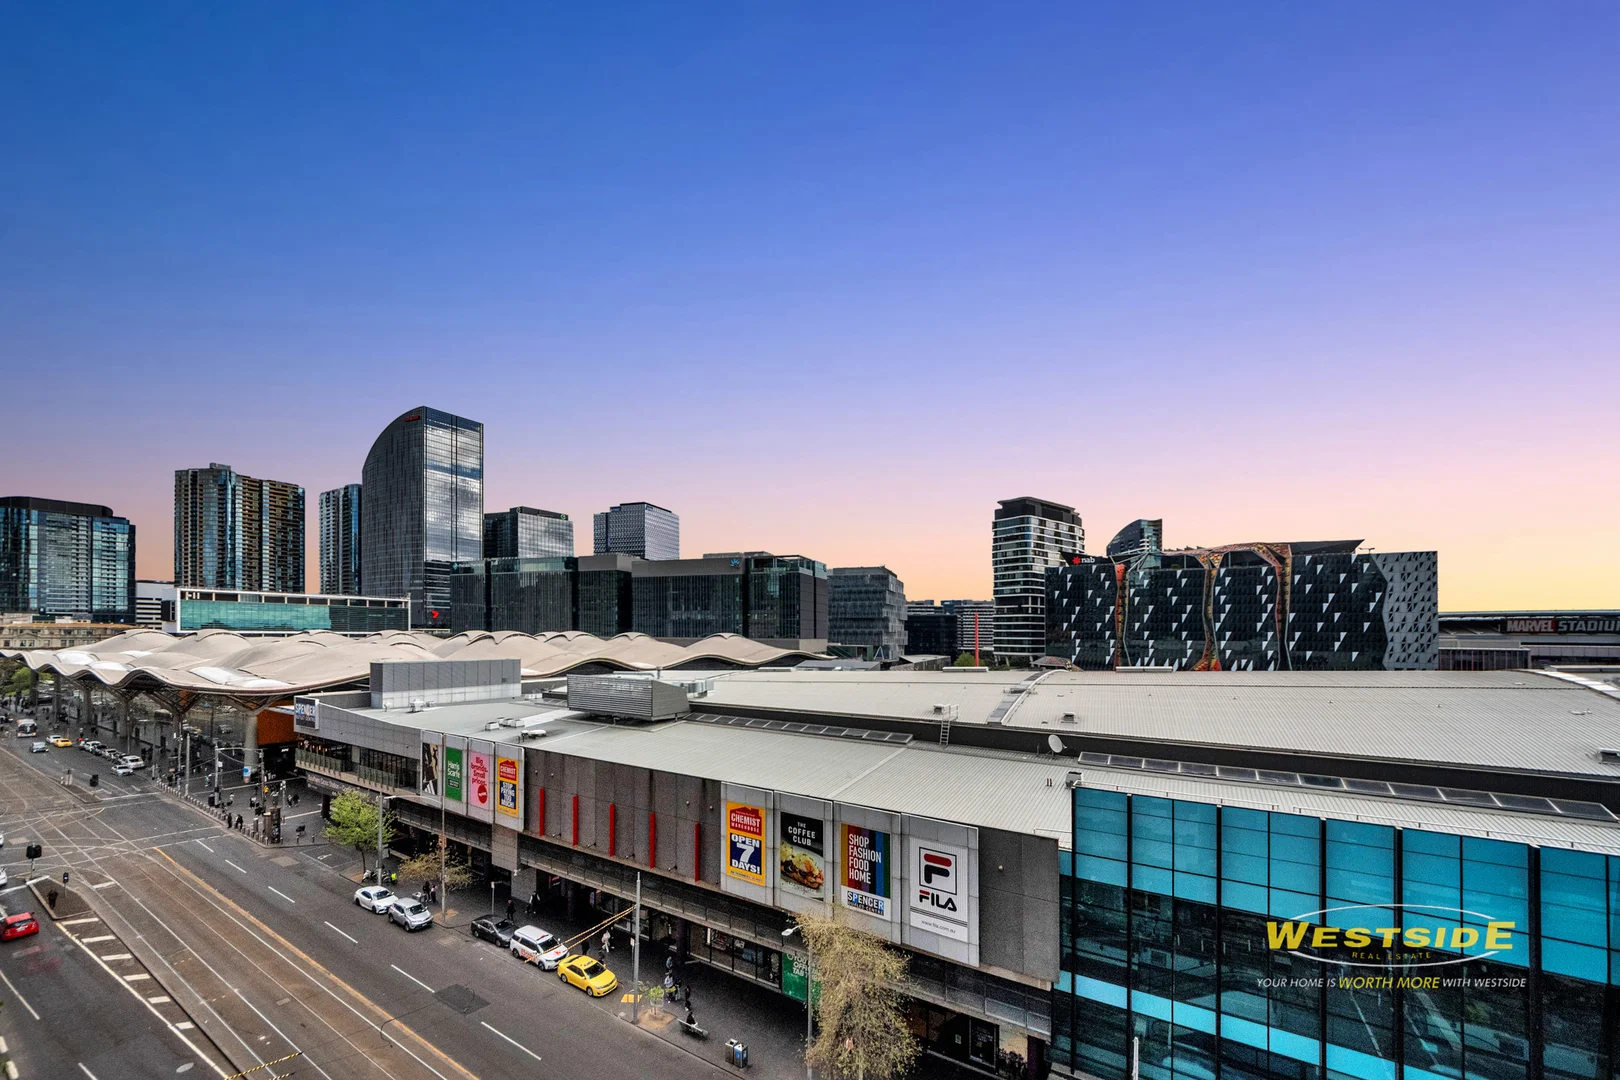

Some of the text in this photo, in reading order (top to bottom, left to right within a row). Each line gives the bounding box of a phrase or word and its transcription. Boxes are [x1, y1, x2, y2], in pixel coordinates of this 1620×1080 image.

[1506, 620, 1554, 632] MARVEL
[500, 765, 516, 775] CHEMIST
[731, 813, 760, 827] CHEMIST
[788, 825, 816, 839] COFFEE
[731, 834, 760, 848] OPEN
[792, 835, 812, 846] CLUB
[849, 833, 870, 848] SHOP
[736, 842, 755, 863] 7
[849, 845, 882, 863] FASHION
[731, 858, 760, 874] DAYS!
[849, 857, 870, 872] FOOD
[849, 868, 871, 884] HOME
[847, 891, 884, 911] SPENCER
[919, 889, 957, 912] FILA
